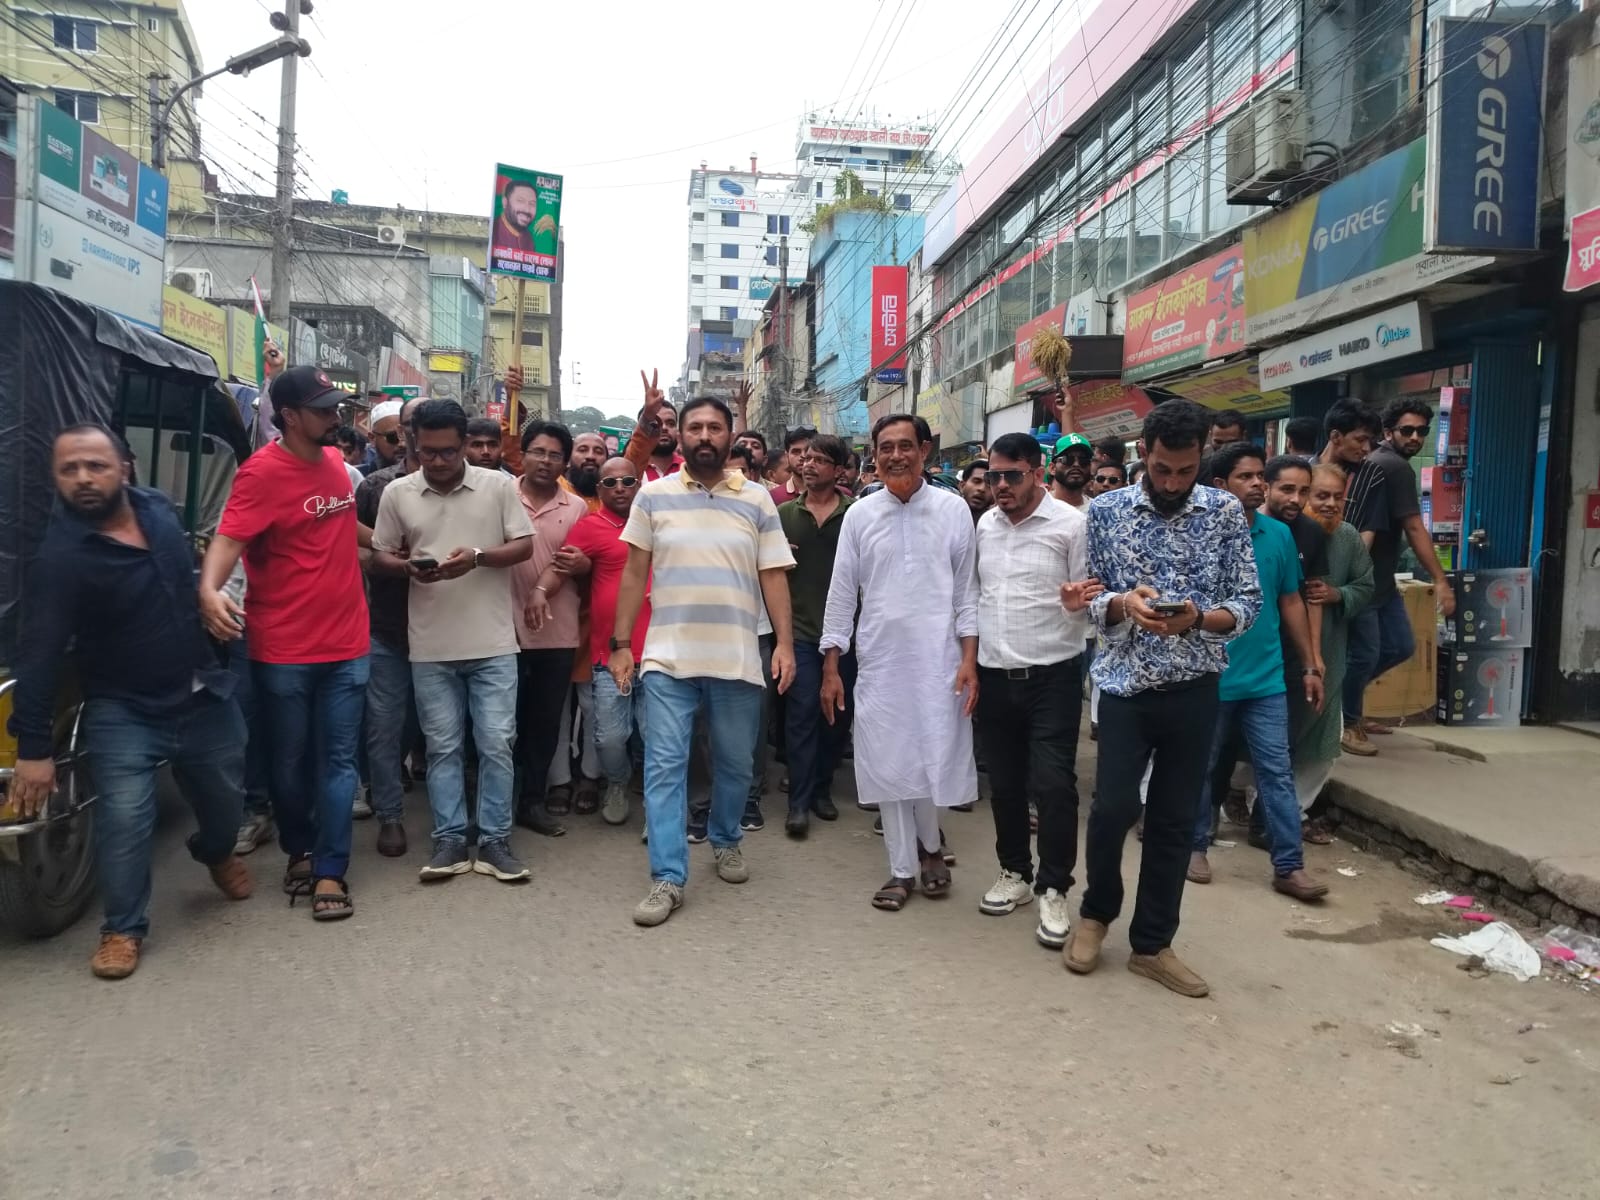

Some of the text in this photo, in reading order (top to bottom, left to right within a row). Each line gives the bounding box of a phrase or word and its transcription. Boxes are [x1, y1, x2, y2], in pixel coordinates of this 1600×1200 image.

[1472, 87, 1508, 238] GREE
[1330, 198, 1390, 246] GREE
[127, 257, 141, 275] IPS
[1263, 360, 1293, 380] KONKA
[1377, 322, 1411, 348] Midea
